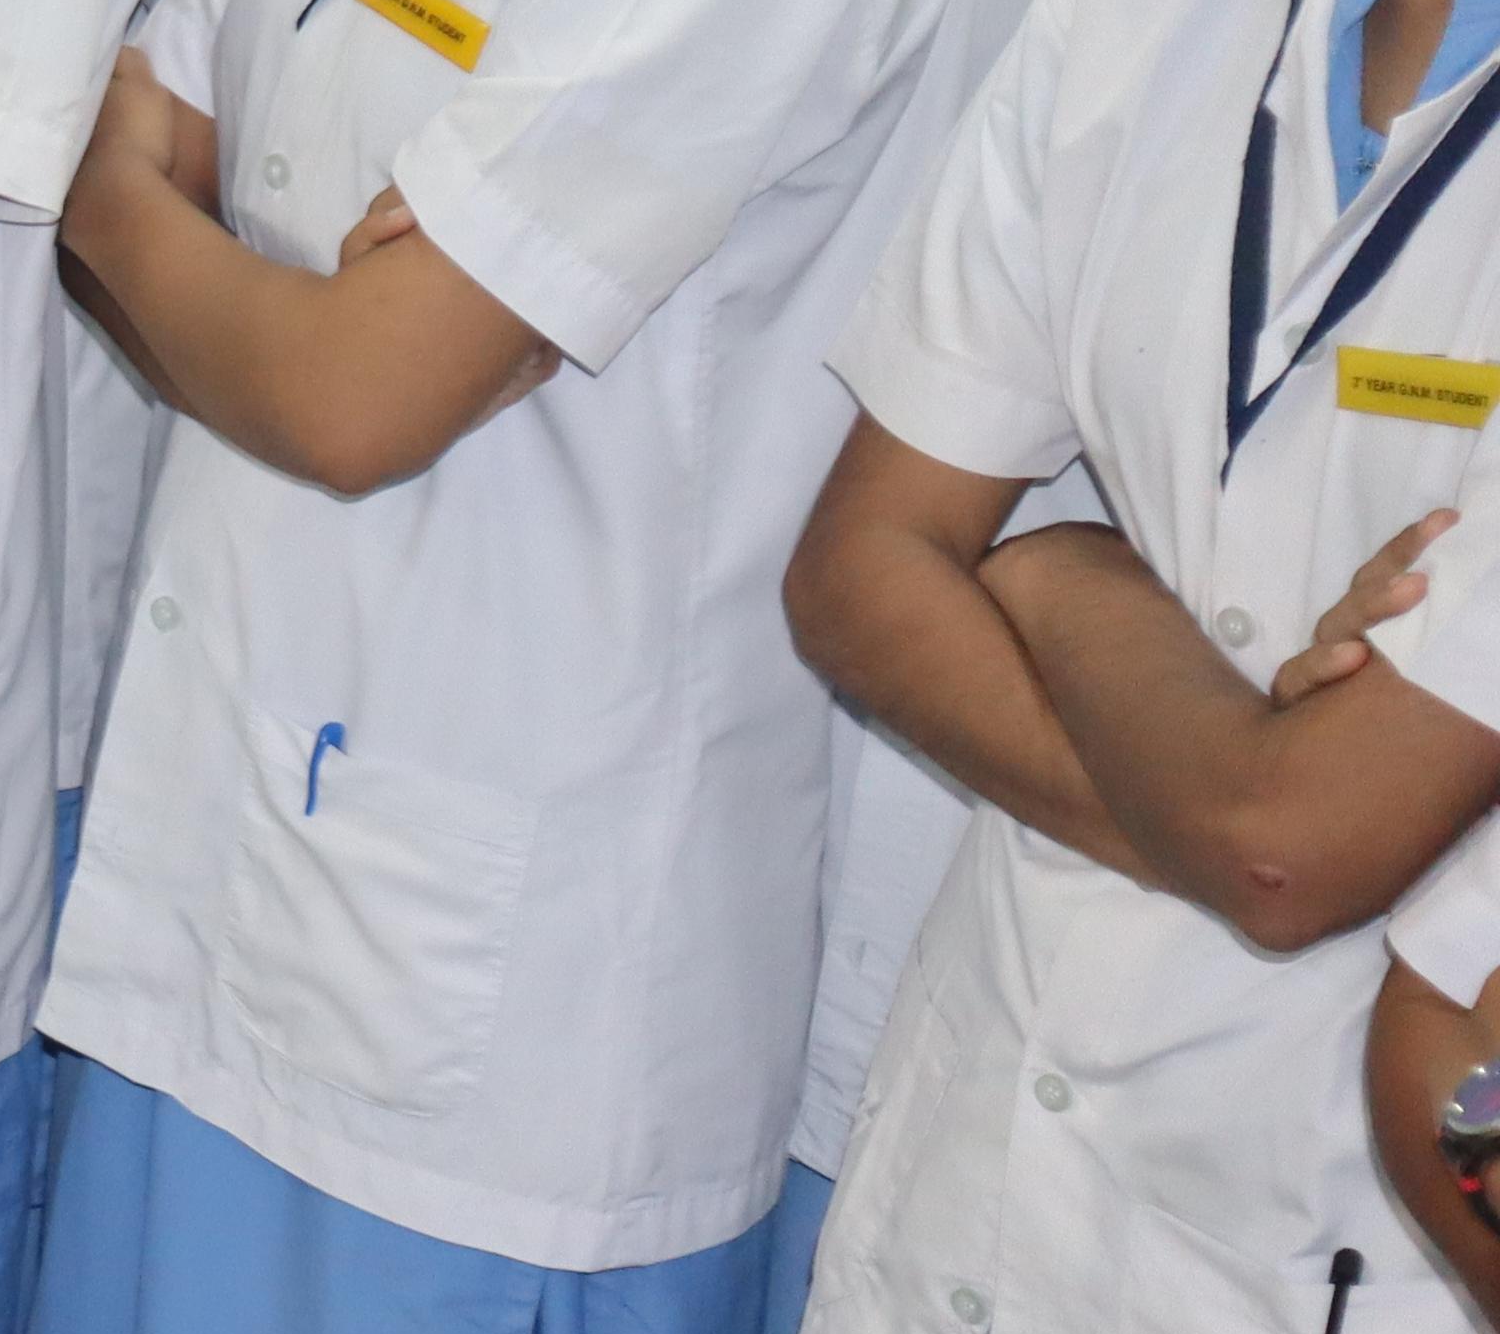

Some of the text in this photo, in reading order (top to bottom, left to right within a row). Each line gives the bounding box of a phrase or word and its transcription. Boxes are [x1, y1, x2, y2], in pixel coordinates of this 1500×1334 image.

[428, 14, 466, 44] STUDENT
[1366, 378, 1396, 393] YEAR
[1436, 389, 1489, 407] STUDENT
